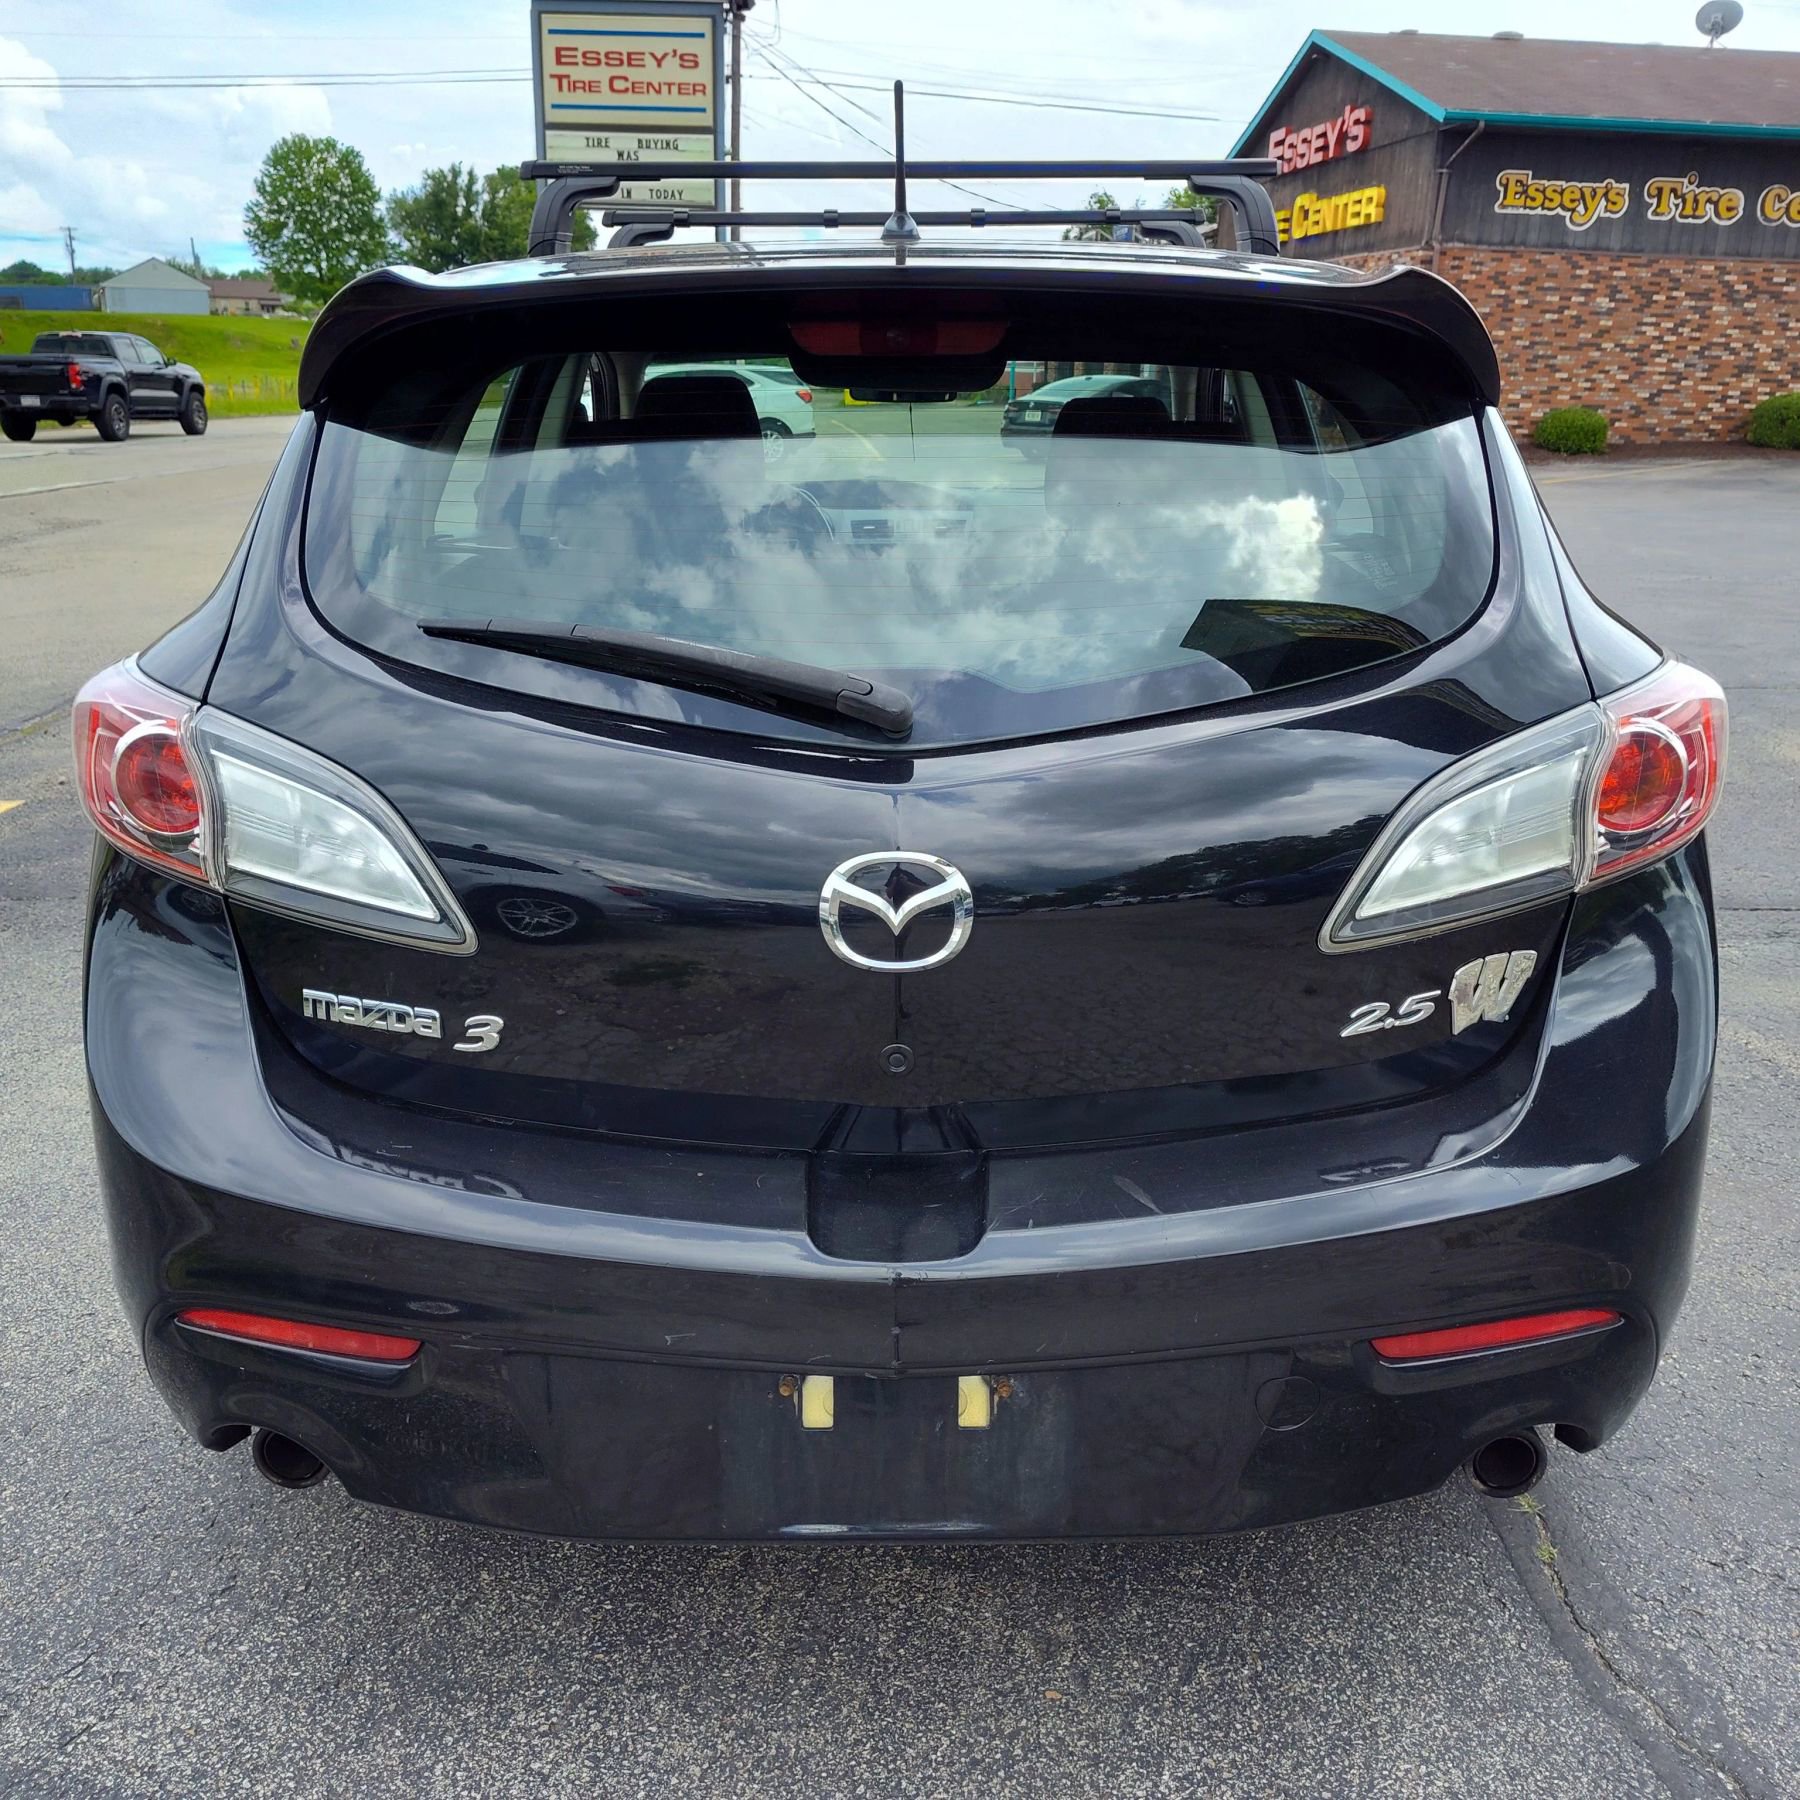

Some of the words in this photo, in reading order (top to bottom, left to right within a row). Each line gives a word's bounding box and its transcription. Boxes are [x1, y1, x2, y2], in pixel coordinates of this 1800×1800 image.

[554, 46, 700, 69] ESSEY'S
[549, 73, 602, 94] TIRE
[608, 75, 707, 97] CENTER
[584, 136, 610, 149] TIRE
[637, 138, 679, 151] BUYING
[1267, 104, 1373, 174] ESSEY'S
[617, 150, 640, 161] WAS
[648, 188, 684, 201] TODAY
[1497, 171, 1627, 227] Essey's
[1647, 172, 1741, 223] Tire
[1291, 185, 1386, 240] CENTER
[1339, 990, 1442, 1037] 2.5
[452, 1015, 505, 1052] 3
